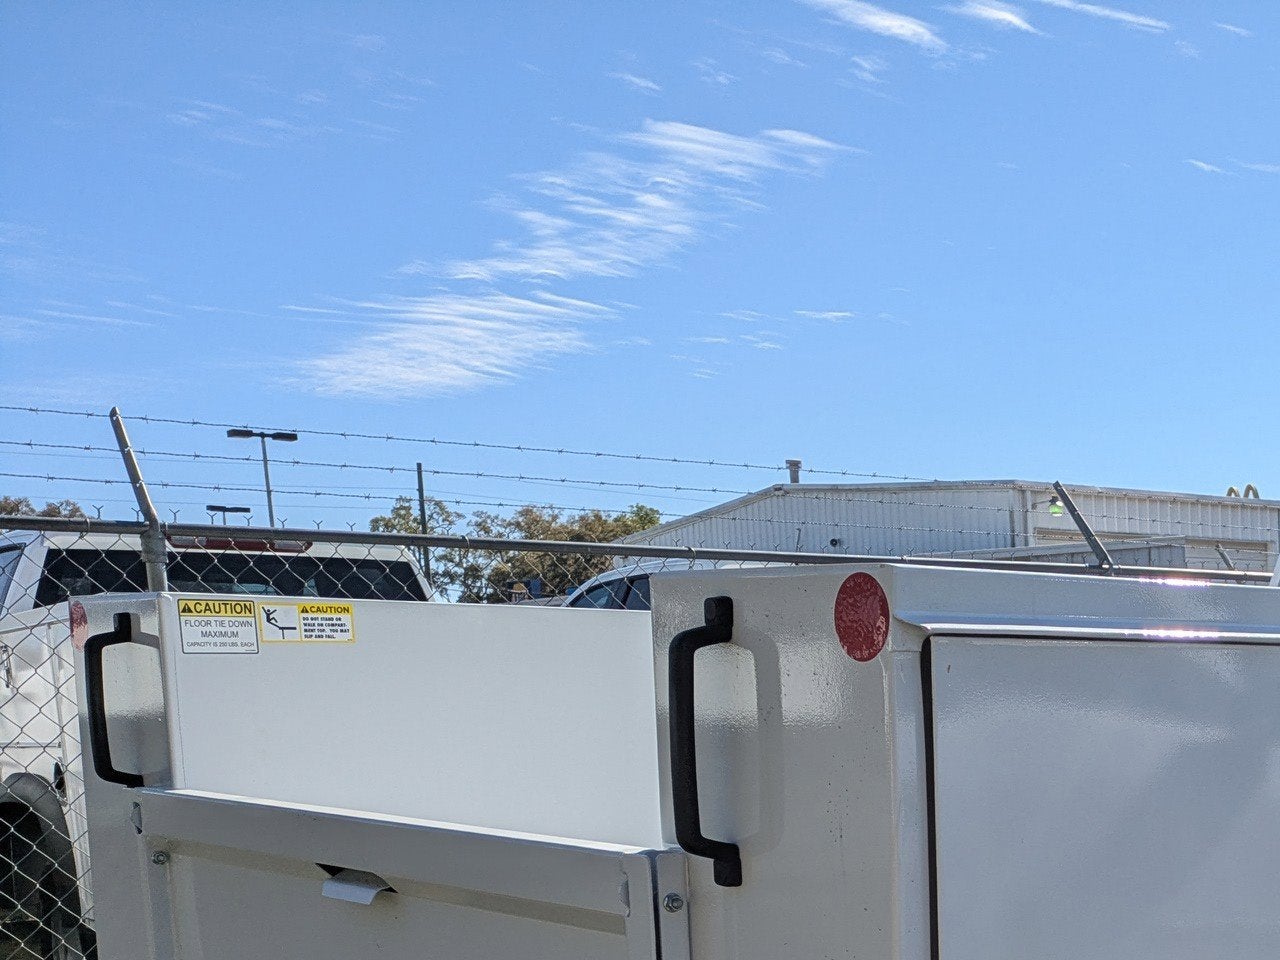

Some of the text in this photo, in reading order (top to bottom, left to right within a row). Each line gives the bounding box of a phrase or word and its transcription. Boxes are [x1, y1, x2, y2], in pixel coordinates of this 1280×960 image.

[193, 602, 252, 614] CAUTION
[309, 606, 350, 614] CAUTION
[184, 620, 253, 628] FLOOR TIE DOWN
[200, 630, 239, 639] MAXIMUM
